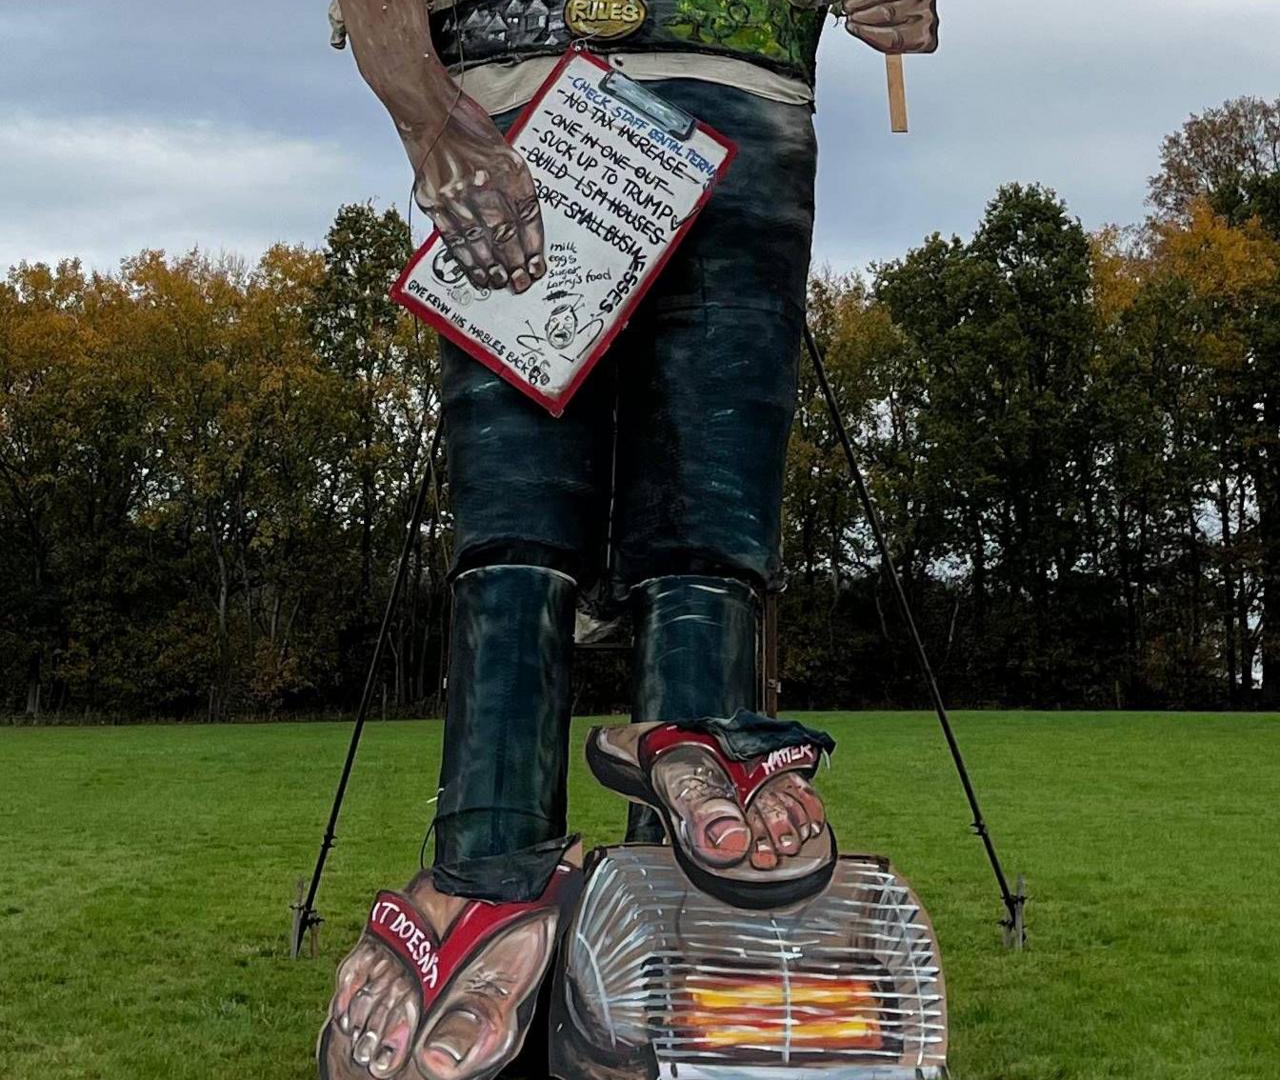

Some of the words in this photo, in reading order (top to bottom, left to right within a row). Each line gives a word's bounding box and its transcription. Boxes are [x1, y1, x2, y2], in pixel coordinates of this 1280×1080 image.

[572, 0, 640, 23] RULES
[611, 107, 650, 130] STAFF
[580, 132, 600, 150] IN
[601, 145, 631, 171] ONE
[634, 166, 669, 191] OUT
[591, 106, 617, 131] TAX
[618, 125, 689, 179] INCREASE
[577, 151, 598, 171] UP
[601, 165, 618, 185] TO
[622, 178, 674, 221] TRUMP
[564, 201, 604, 238] SMALL
[607, 197, 665, 246] HOUSES
[548, 255, 577, 267] eggs
[550, 241, 577, 254] milk
[586, 267, 611, 283] food
[408, 279, 429, 299] GIVE
[426, 293, 452, 315] KEVIN
[451, 312, 467, 328] HIS
[468, 323, 506, 355] MARBLES
[505, 351, 530, 374] BACK
[372, 902, 400, 924] IT
[389, 912, 439, 988] DOESN'T
